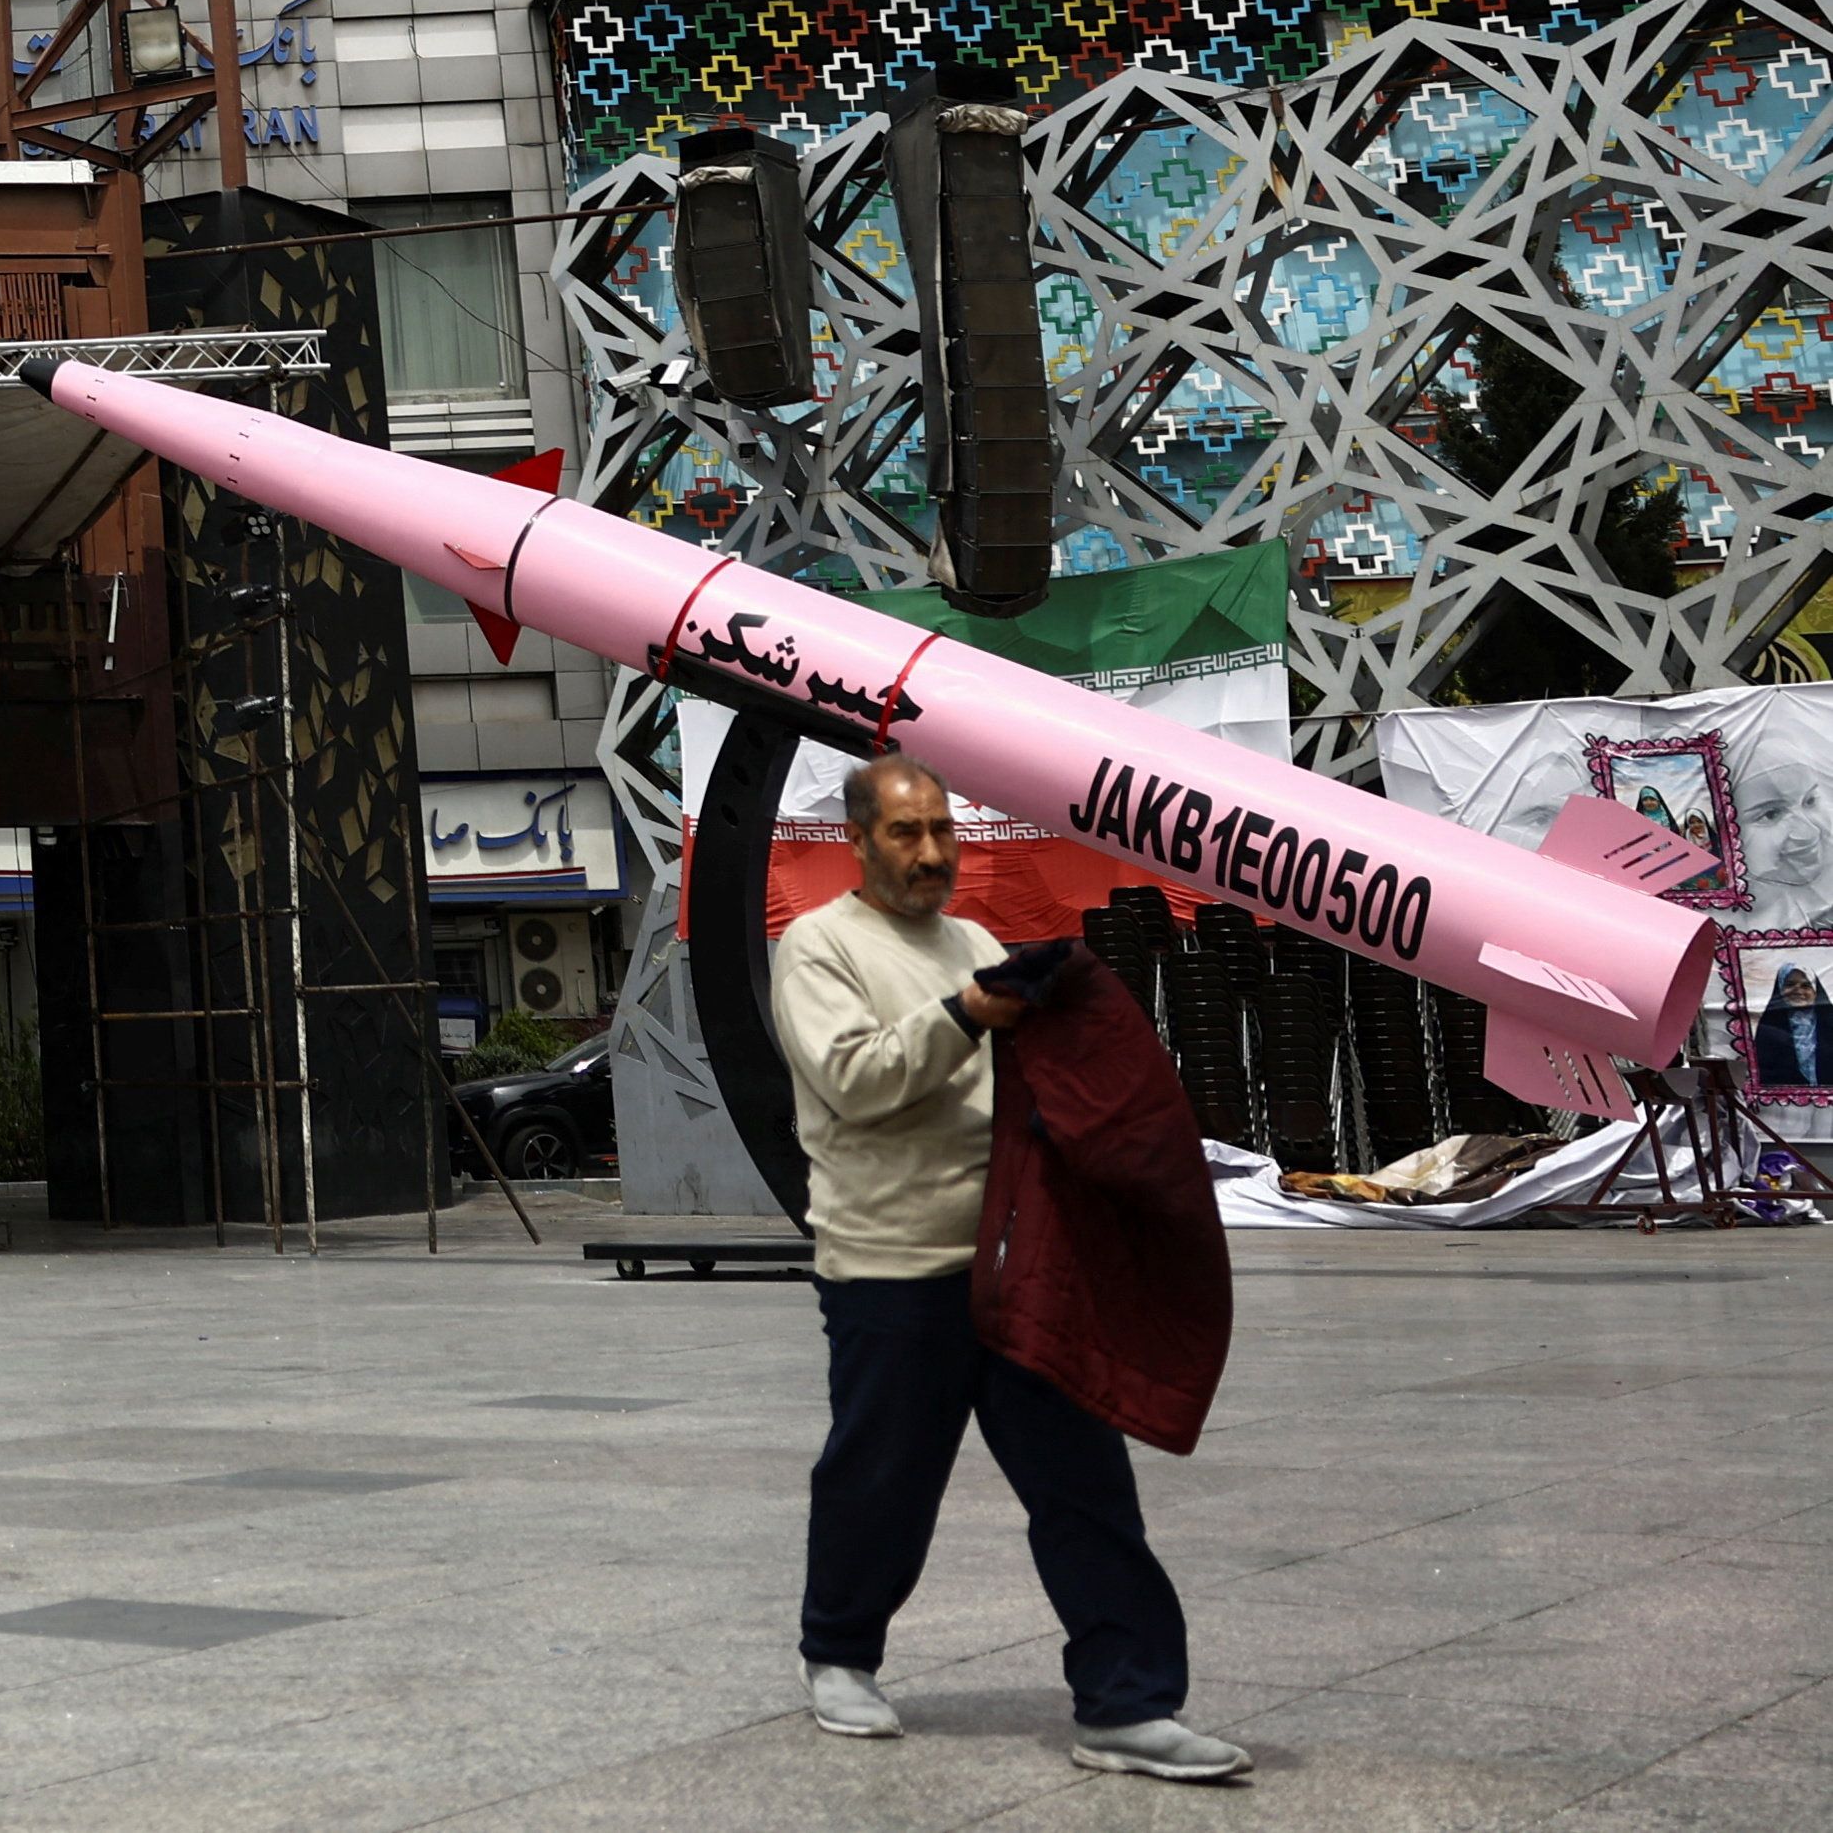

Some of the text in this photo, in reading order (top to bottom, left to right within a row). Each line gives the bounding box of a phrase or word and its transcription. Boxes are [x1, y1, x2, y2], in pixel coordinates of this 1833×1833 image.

[239, 103, 318, 146] RAN
[476, 782, 577, 862] بانک
[1069, 756, 1432, 962] JAKB1E00500
